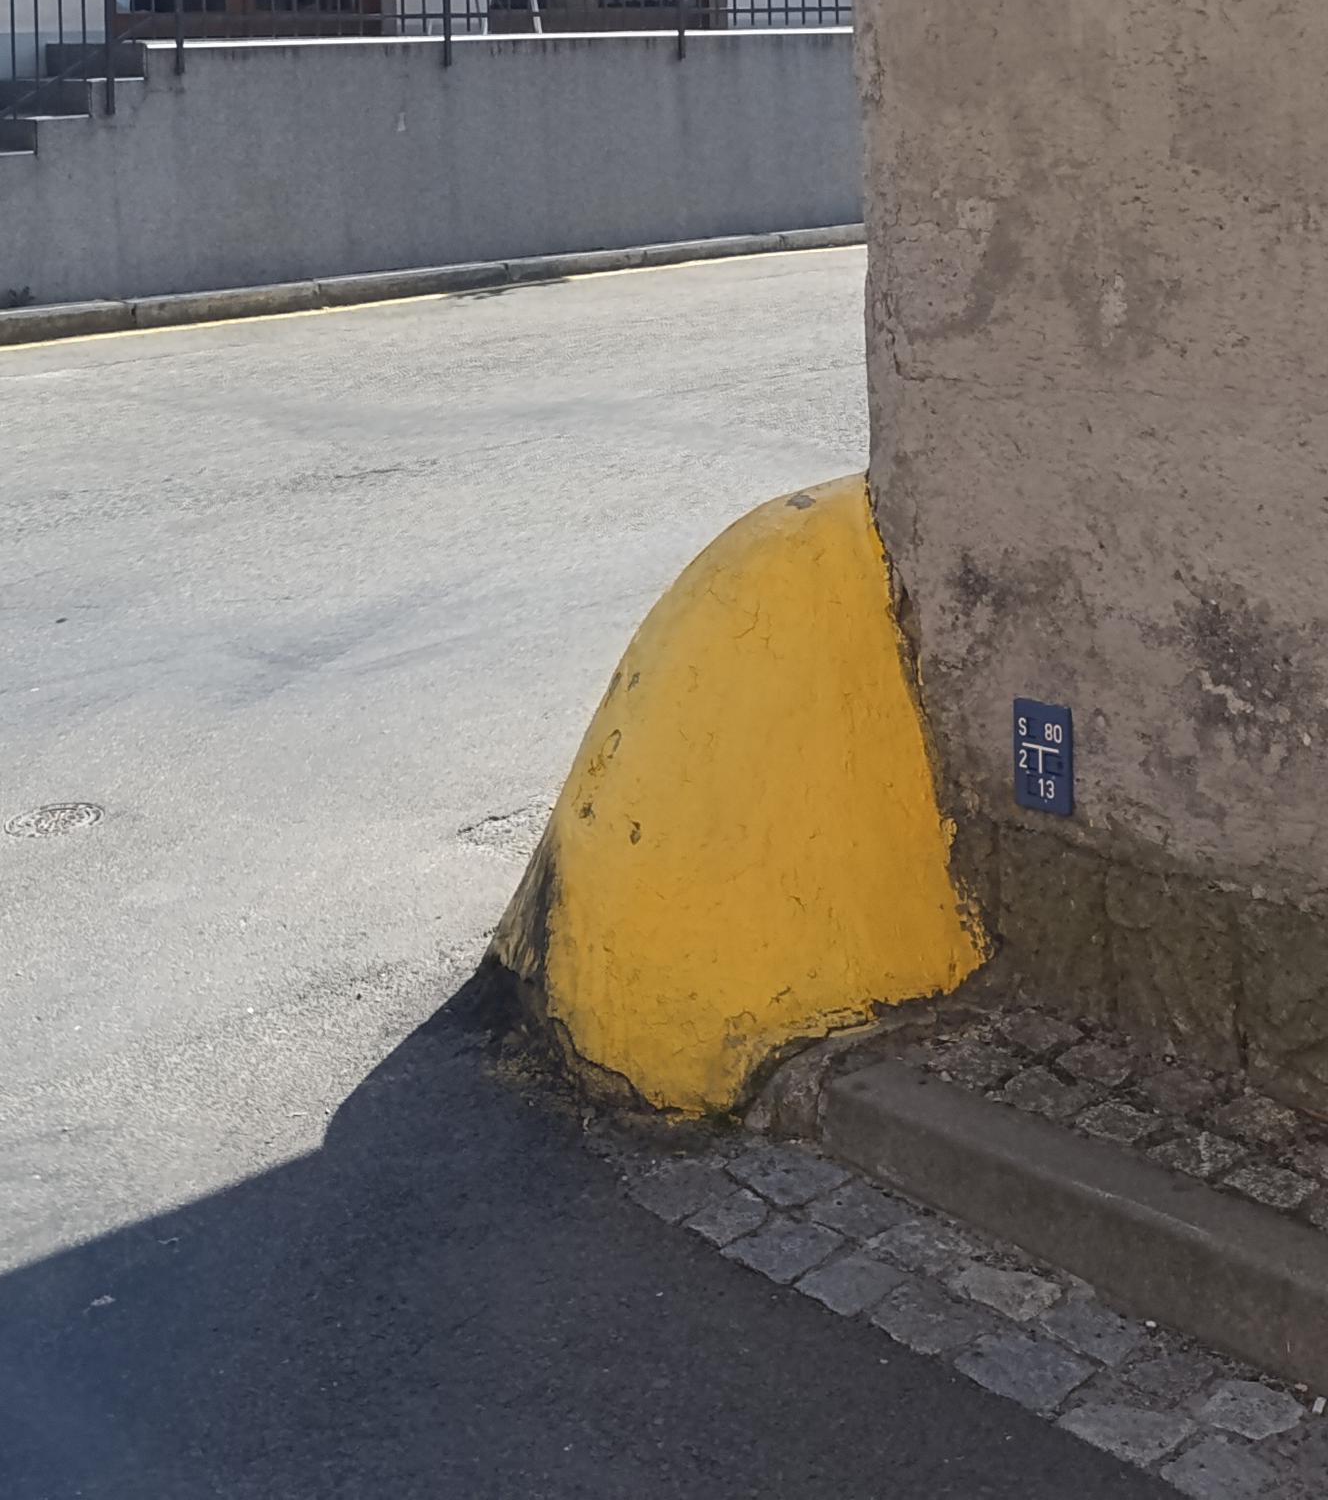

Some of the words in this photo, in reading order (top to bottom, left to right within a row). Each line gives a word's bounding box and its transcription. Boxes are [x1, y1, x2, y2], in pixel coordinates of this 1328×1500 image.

[1018, 717, 1027, 736] S
[1044, 723, 1062, 744] 80
[1019, 749, 1028, 768] 2
[1038, 778, 1055, 799] 13
